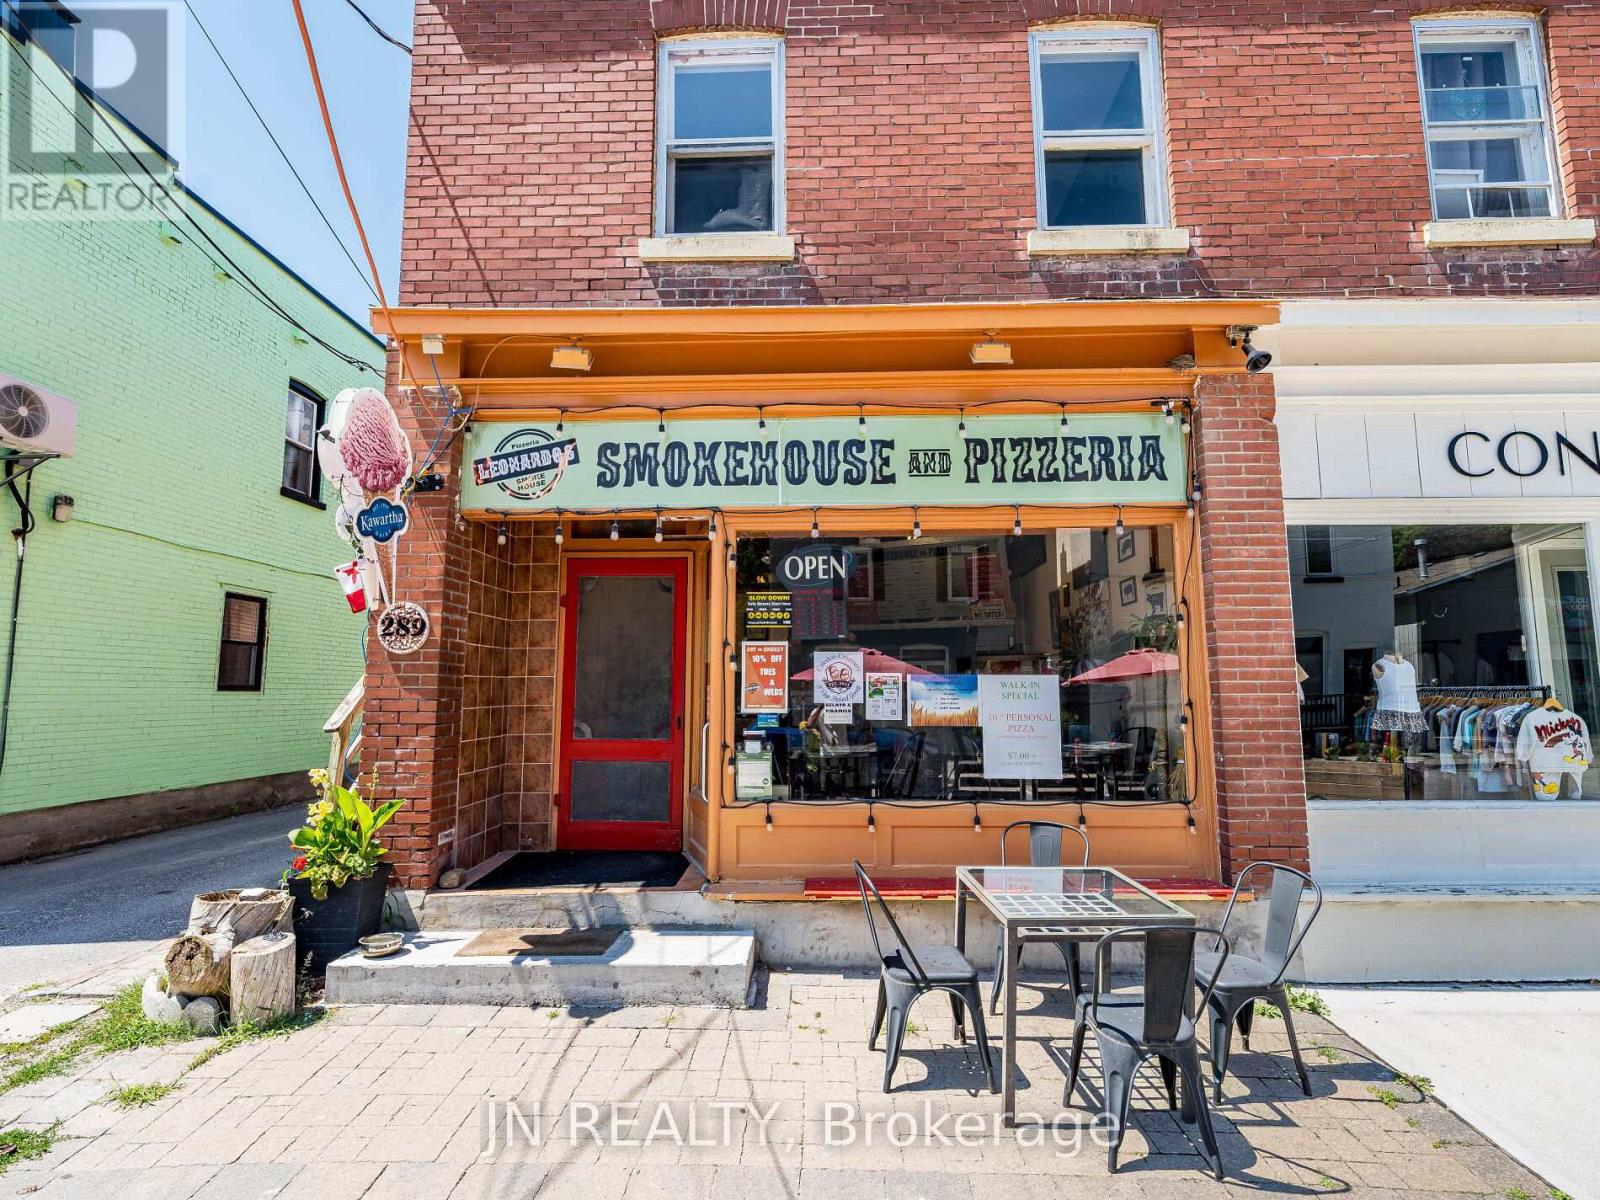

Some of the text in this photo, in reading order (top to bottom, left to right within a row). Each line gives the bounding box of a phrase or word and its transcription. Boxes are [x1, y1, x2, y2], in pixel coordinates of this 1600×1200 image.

[511, 439, 540, 450] Pizzeria
[1447, 431, 1600, 477] CON
[597, 435, 1168, 488] SMOKEHOUSE AND PIZZERIA
[516, 473, 546, 485] SMOKE
[517, 480, 546, 491] HOUSE
[360, 511, 403, 531] Kawartha
[784, 555, 846, 580] OPEN
[379, 615, 426, 638] 289
[752, 655, 783, 663] 10% OFF
[759, 668, 776, 676] TUES
[1000, 681, 1040, 689] WALK-IN
[763, 688, 784, 696] WEDS
[1001, 692, 1040, 700] SPECIAL
[1006, 713, 1056, 721] PERSONAL
[1007, 724, 1036, 732] PIZZA
[1534, 716, 1581, 742] Mickey
